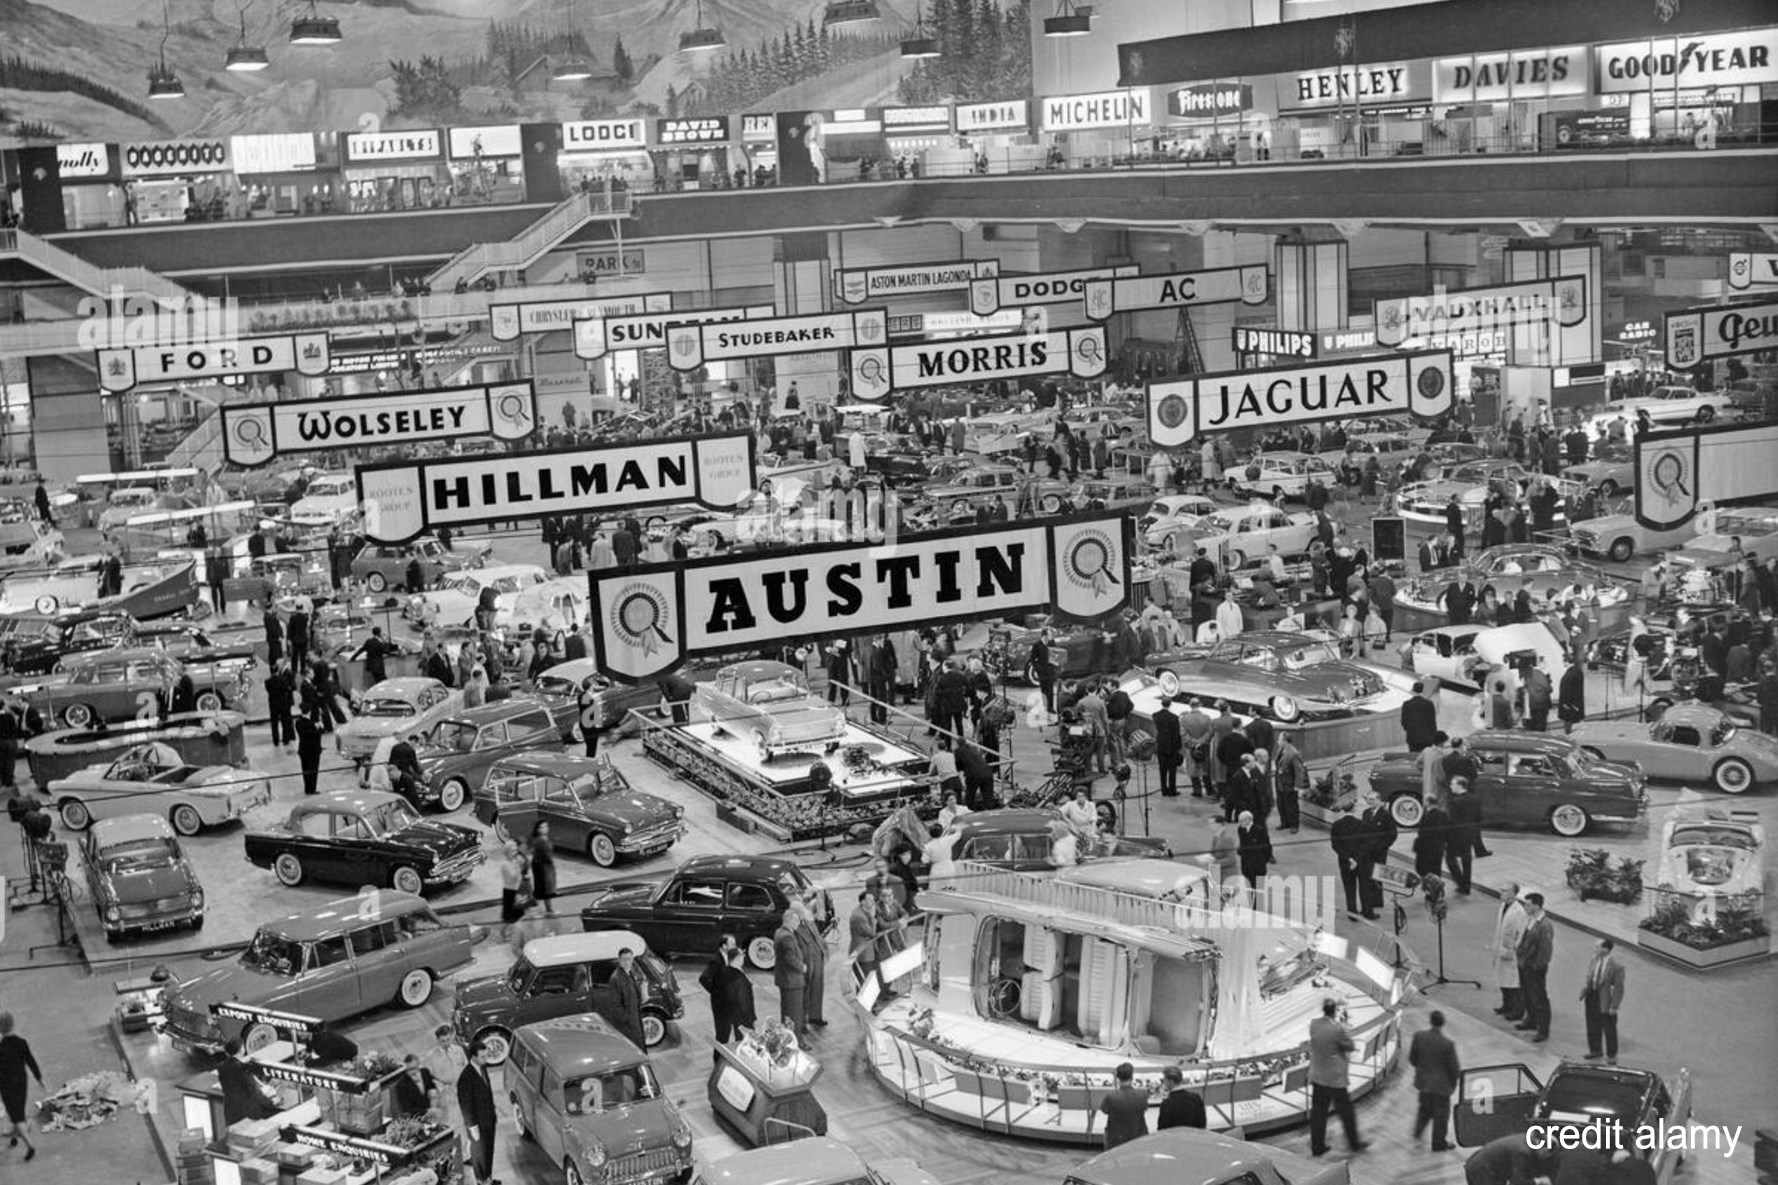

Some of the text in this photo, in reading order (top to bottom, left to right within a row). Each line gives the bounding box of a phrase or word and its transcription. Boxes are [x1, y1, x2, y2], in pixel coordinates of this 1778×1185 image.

[1453, 55, 1569, 89] DAVIES
[1609, 43, 1768, 79] GOODYEAR
[1297, 68, 1405, 100] HENLEY
[1050, 96, 1144, 125] MICHELIN
[1177, 90, 1241, 114] Firestone
[665, 120, 720, 132] DAVID
[971, 107, 1016, 124] INDIA
[661, 129, 724, 142] BROWN
[585, 256, 629, 270] PARK
[870, 268, 972, 289] ASTON MARTIN LAGONDA
[1014, 280, 1084, 298] DODG
[1159, 278, 1197, 303] AC
[1414, 294, 1548, 322] VAUXHALL
[719, 325, 834, 348] STUDEBAKER
[1619, 329, 1657, 340] RADIO
[1625, 321, 1650, 331] CAR
[1248, 331, 1313, 357] PHILIPS
[1336, 331, 1374, 348] PHILI
[161, 346, 272, 373] FORD
[918, 341, 1047, 377] MORRIS
[1208, 369, 1393, 425] JAGUAR
[297, 405, 466, 441] WOLSELEY
[703, 455, 744, 466] ROOTES
[433, 454, 687, 510] HILLMAN
[705, 542, 1026, 634] AUSTIN
[217, 1007, 308, 1031] EXPORT ENQUIRIES
[262, 1067, 339, 1089] LITERATURE
[296, 1133, 388, 1162] HOME ENQUIRIES
